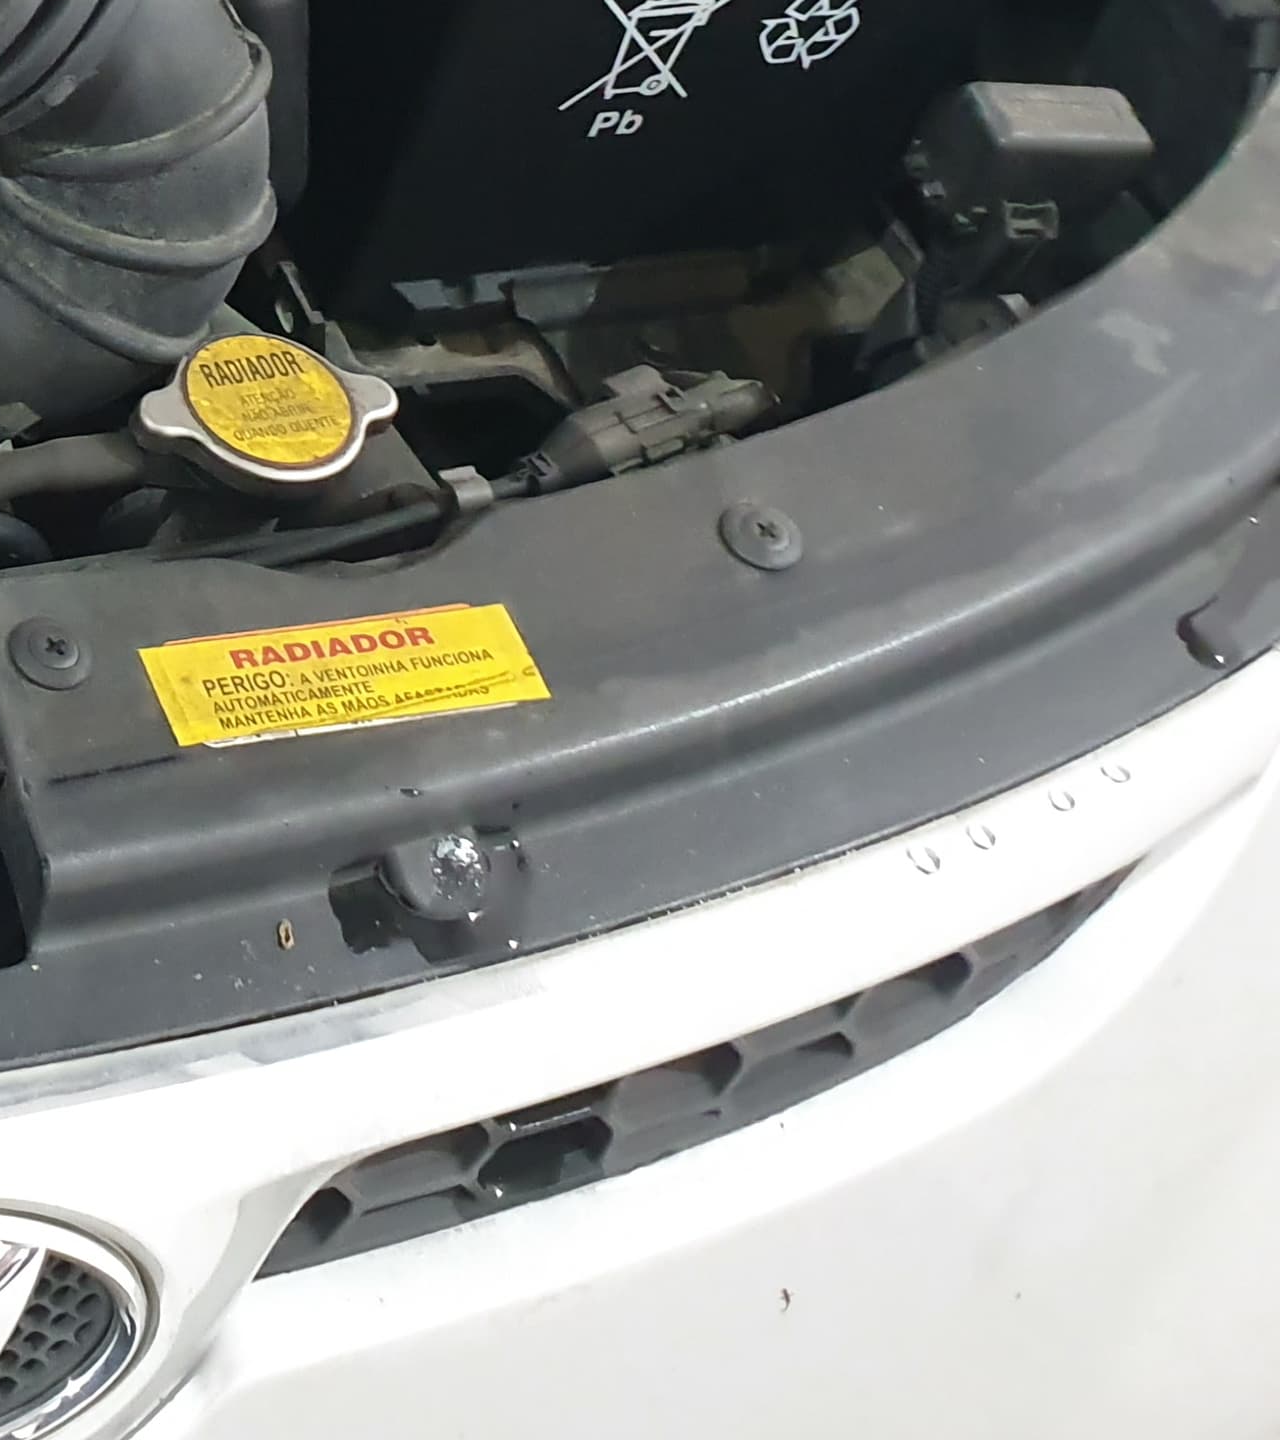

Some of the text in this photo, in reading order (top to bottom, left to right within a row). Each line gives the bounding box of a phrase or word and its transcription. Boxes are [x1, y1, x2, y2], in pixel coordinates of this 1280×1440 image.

[587, 109, 644, 138] Pb
[199, 350, 305, 389] RADIADOR
[233, 415, 341, 442] QUANDO QUENTE
[229, 626, 436, 670] RADIADOR
[202, 648, 495, 698] PERIGO: A VENTOINHA FUNCIONA
[218, 706, 313, 730] MANTENHA
[316, 702, 339, 716] AS
